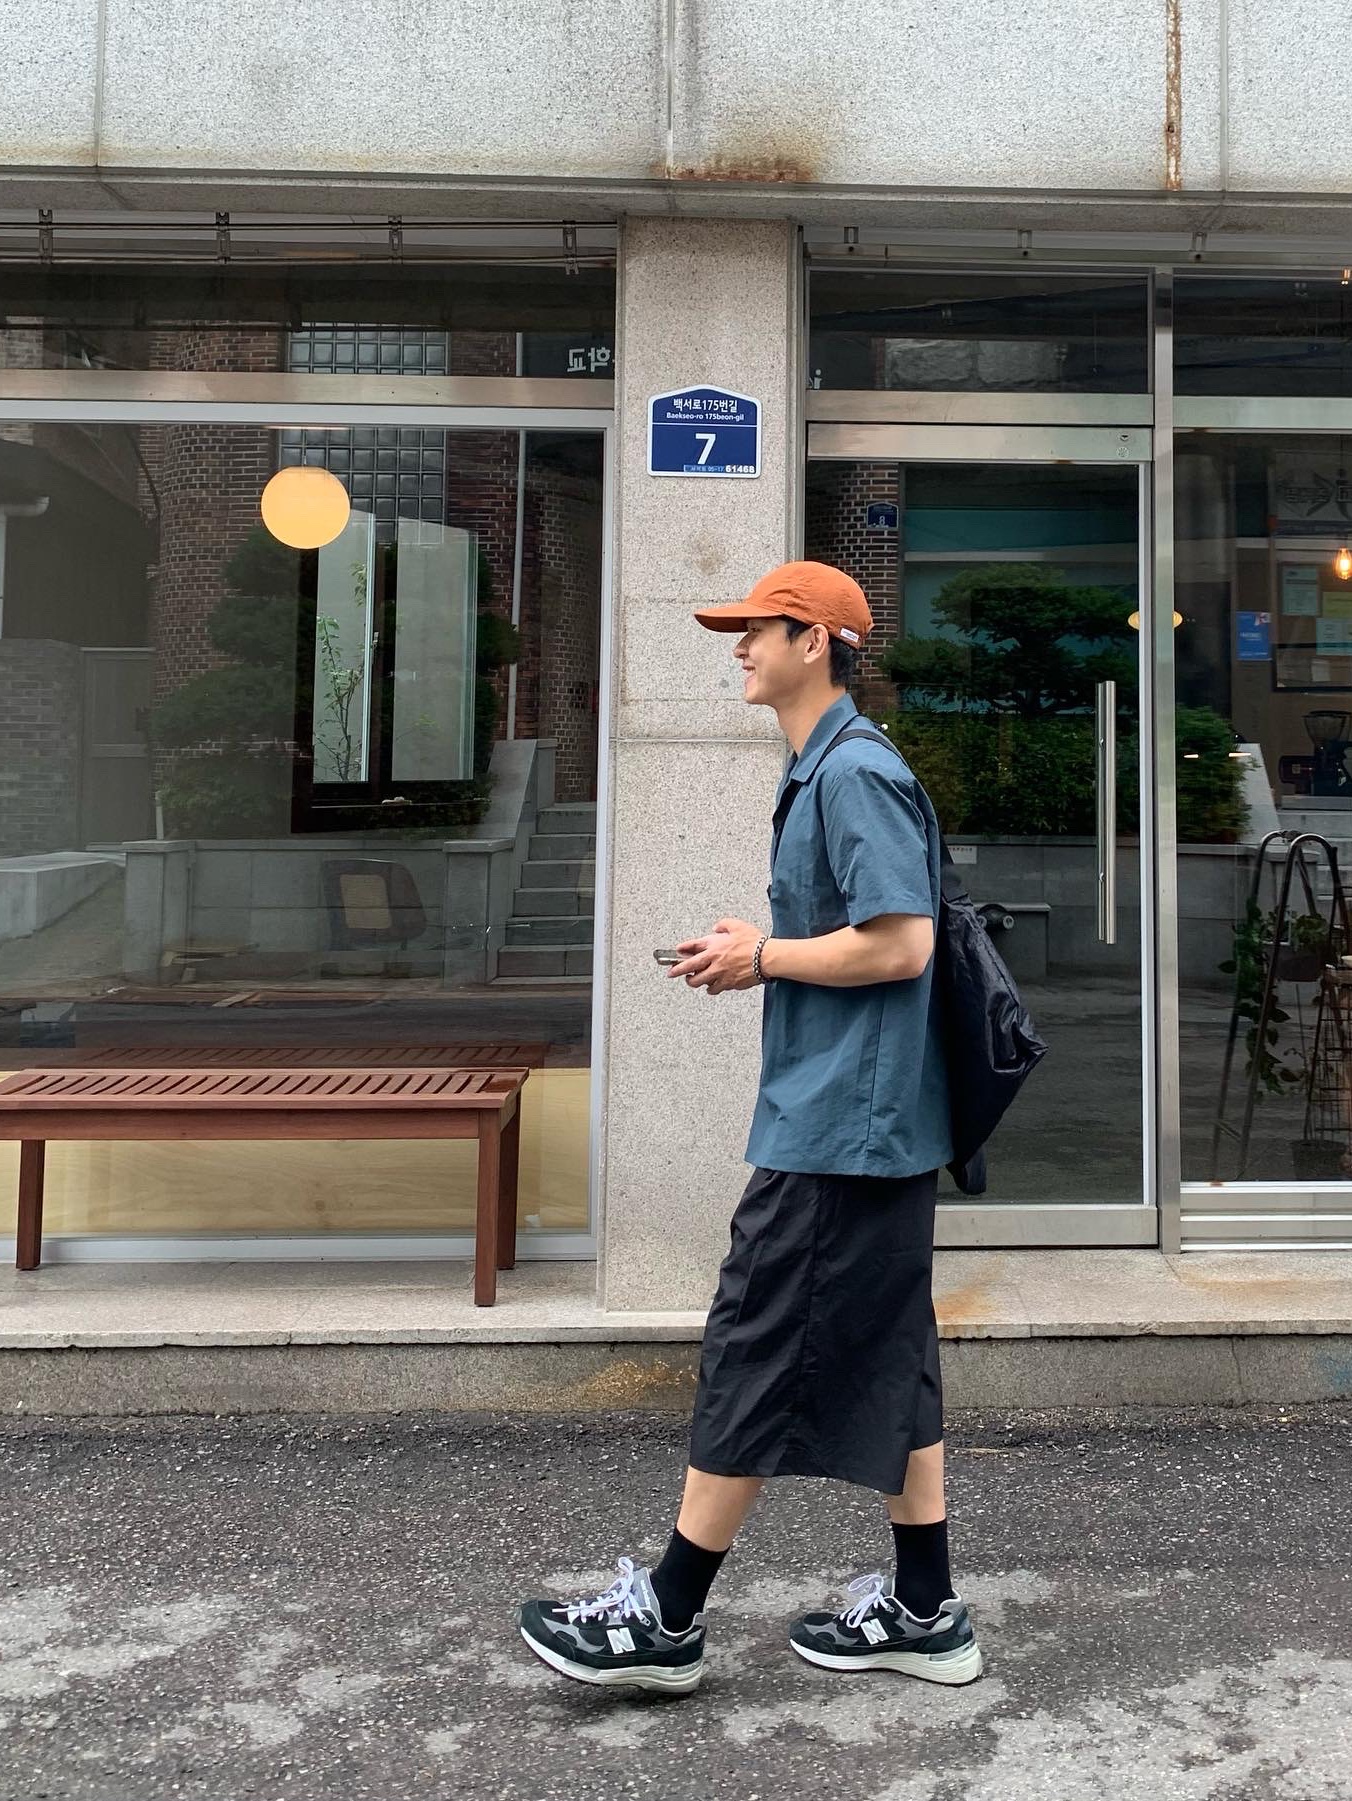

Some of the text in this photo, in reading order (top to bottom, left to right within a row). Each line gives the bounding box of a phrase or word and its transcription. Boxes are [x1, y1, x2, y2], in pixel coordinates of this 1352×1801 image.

[673, 398, 738, 413] 백서로175번길
[666, 411, 745, 422] Baekseo-ro 175beon-gil
[695, 433, 716, 465] 7
[725, 464, 755, 473] 61468
[606, 1627, 637, 1655] N
[860, 1617, 889, 1645] N
